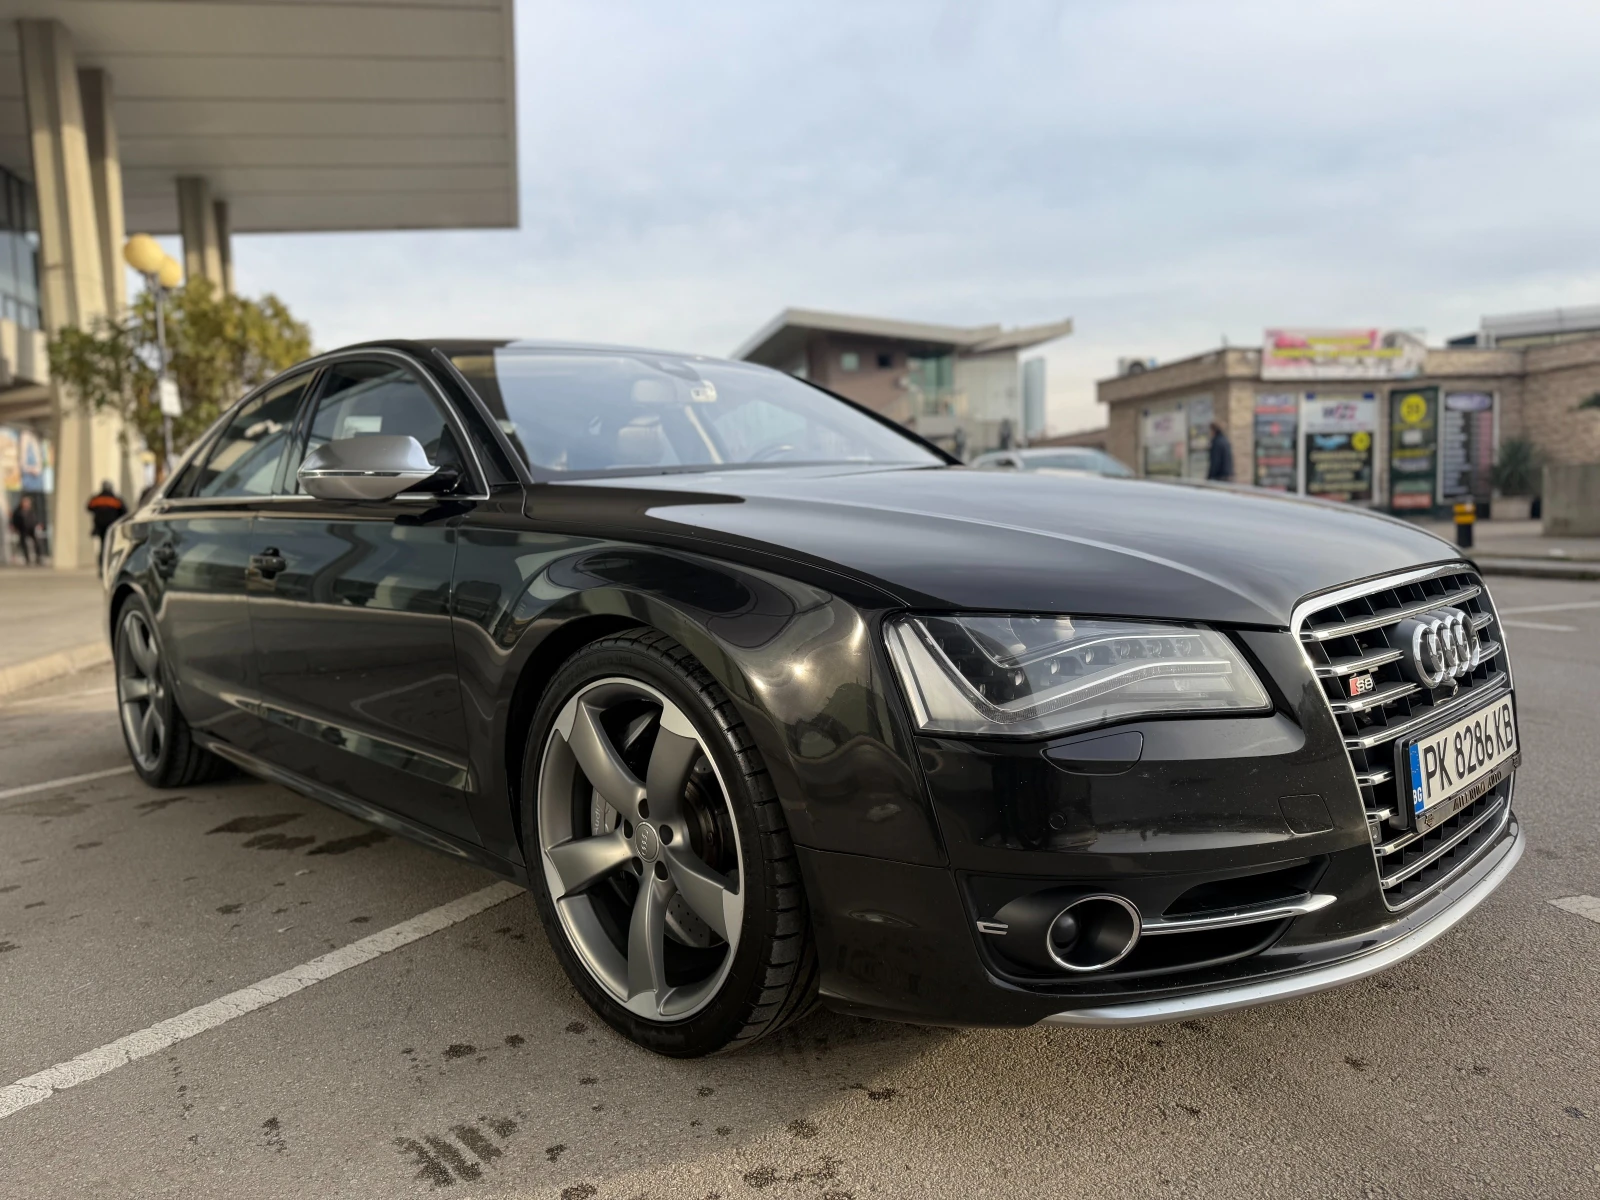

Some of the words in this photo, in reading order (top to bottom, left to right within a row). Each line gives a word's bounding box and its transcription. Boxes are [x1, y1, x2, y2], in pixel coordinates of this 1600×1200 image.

[1356, 678, 1373, 691] S8
[1423, 736, 1453, 798] PK
[1454, 714, 1494, 779] 8286
[1493, 703, 1513, 755] KB
[1412, 786, 1422, 805] BG
